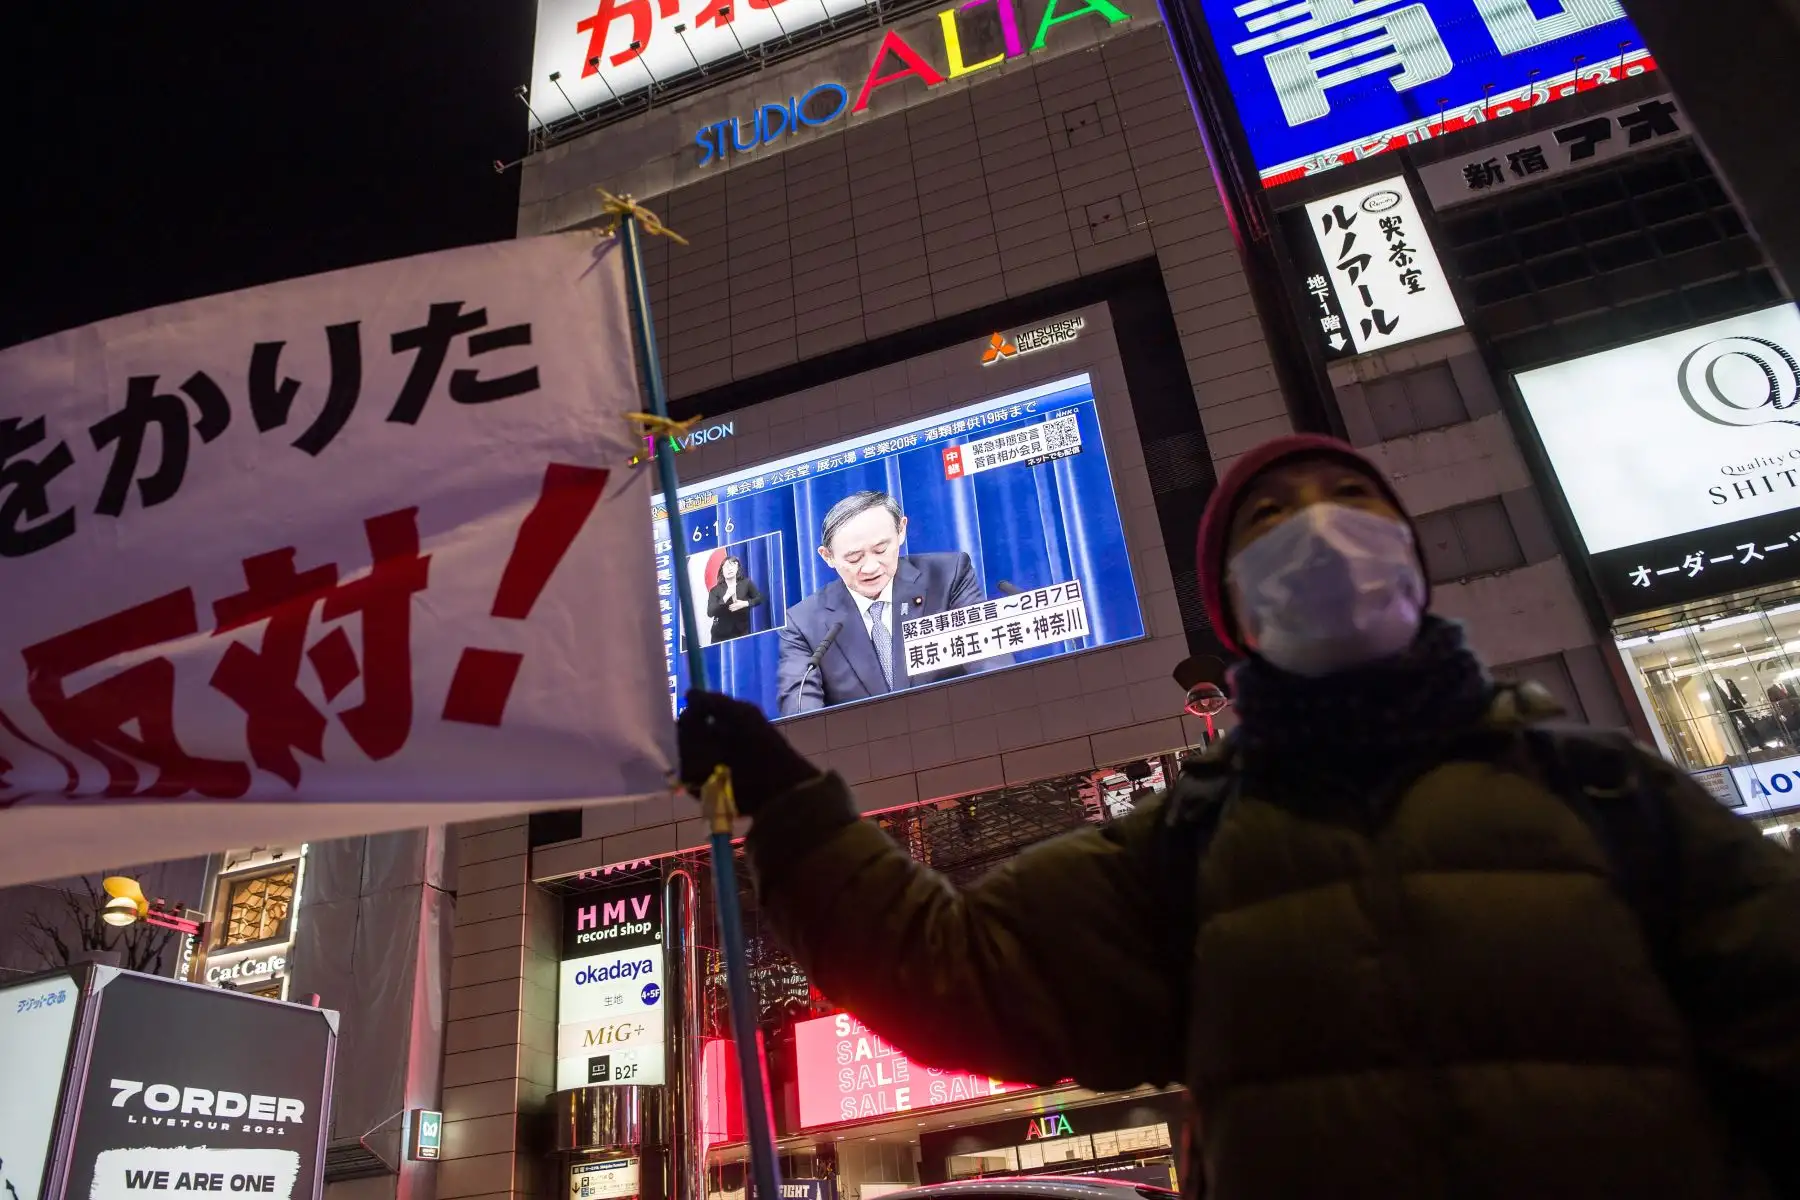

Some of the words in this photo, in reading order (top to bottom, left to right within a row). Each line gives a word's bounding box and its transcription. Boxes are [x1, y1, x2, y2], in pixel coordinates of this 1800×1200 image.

[695, 82, 848, 165] STUDIO
[852, 0, 1132, 113] ALTA
[1321, 204, 1400, 342] ルノアール
[1306, 273, 1342, 333] 地下1階
[1016, 316, 1083, 343] MITSUBISHI
[1018, 328, 1077, 353] ELECTRIC
[974, 441, 1044, 469] 菅首相が会見
[1721, 455, 1785, 476] Quality
[1708, 469, 1797, 505] SHIT
[692, 517, 735, 542] 6:16
[0, 462, 611, 798] 反対!
[903, 602, 999, 640] 緊急事態宣言
[577, 894, 651, 931] HMV
[577, 925, 618, 944] record
[620, 921, 651, 937] shop
[206, 965, 241, 983] Cat
[241, 956, 286, 975] Cafe
[575, 959, 653, 985] okadaya
[615, 1064, 638, 1080] B2F
[838, 1056, 910, 1093] SALE
[840, 1086, 912, 1121] SALE
[128, 1115, 231, 1131] LIVETOUR
[242, 1125, 285, 1135] 2021
[1025, 1113, 1074, 1141] ALTA
[125, 1169, 170, 1190] WE
[174, 1172, 224, 1191] ARE
[230, 1174, 276, 1193] ONE
